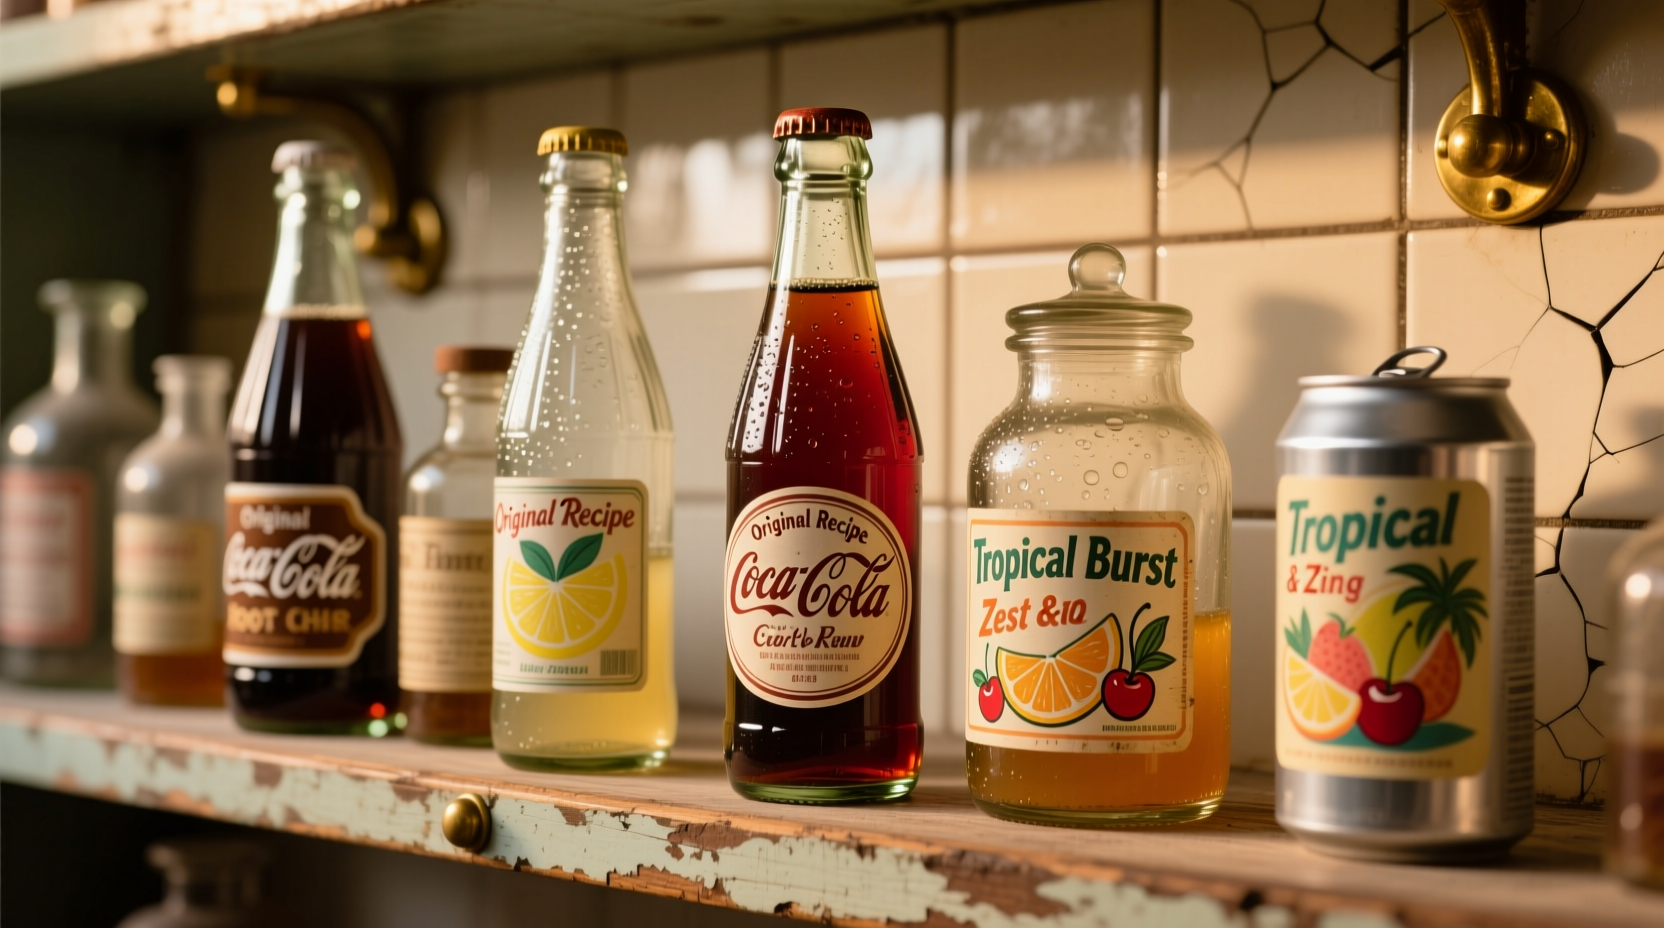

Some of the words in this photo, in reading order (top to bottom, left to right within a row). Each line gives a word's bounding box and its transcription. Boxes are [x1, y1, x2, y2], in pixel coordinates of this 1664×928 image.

[239, 504, 311, 535] Original
[495, 498, 557, 538] Original
[560, 497, 635, 535] Recipe
[751, 508, 811, 541] Original
[816, 509, 869, 544] Recipe
[1289, 492, 1460, 565] Tropical
[222, 531, 366, 599] Coca-Cola
[973, 535, 1078, 592] Tropical
[1085, 535, 1178, 589] Burst
[1287, 565, 1299, 593] &
[1303, 564, 1365, 604] Zing
[730, 551, 896, 618] Coca-Cola
[978, 598, 1031, 638] Zest
